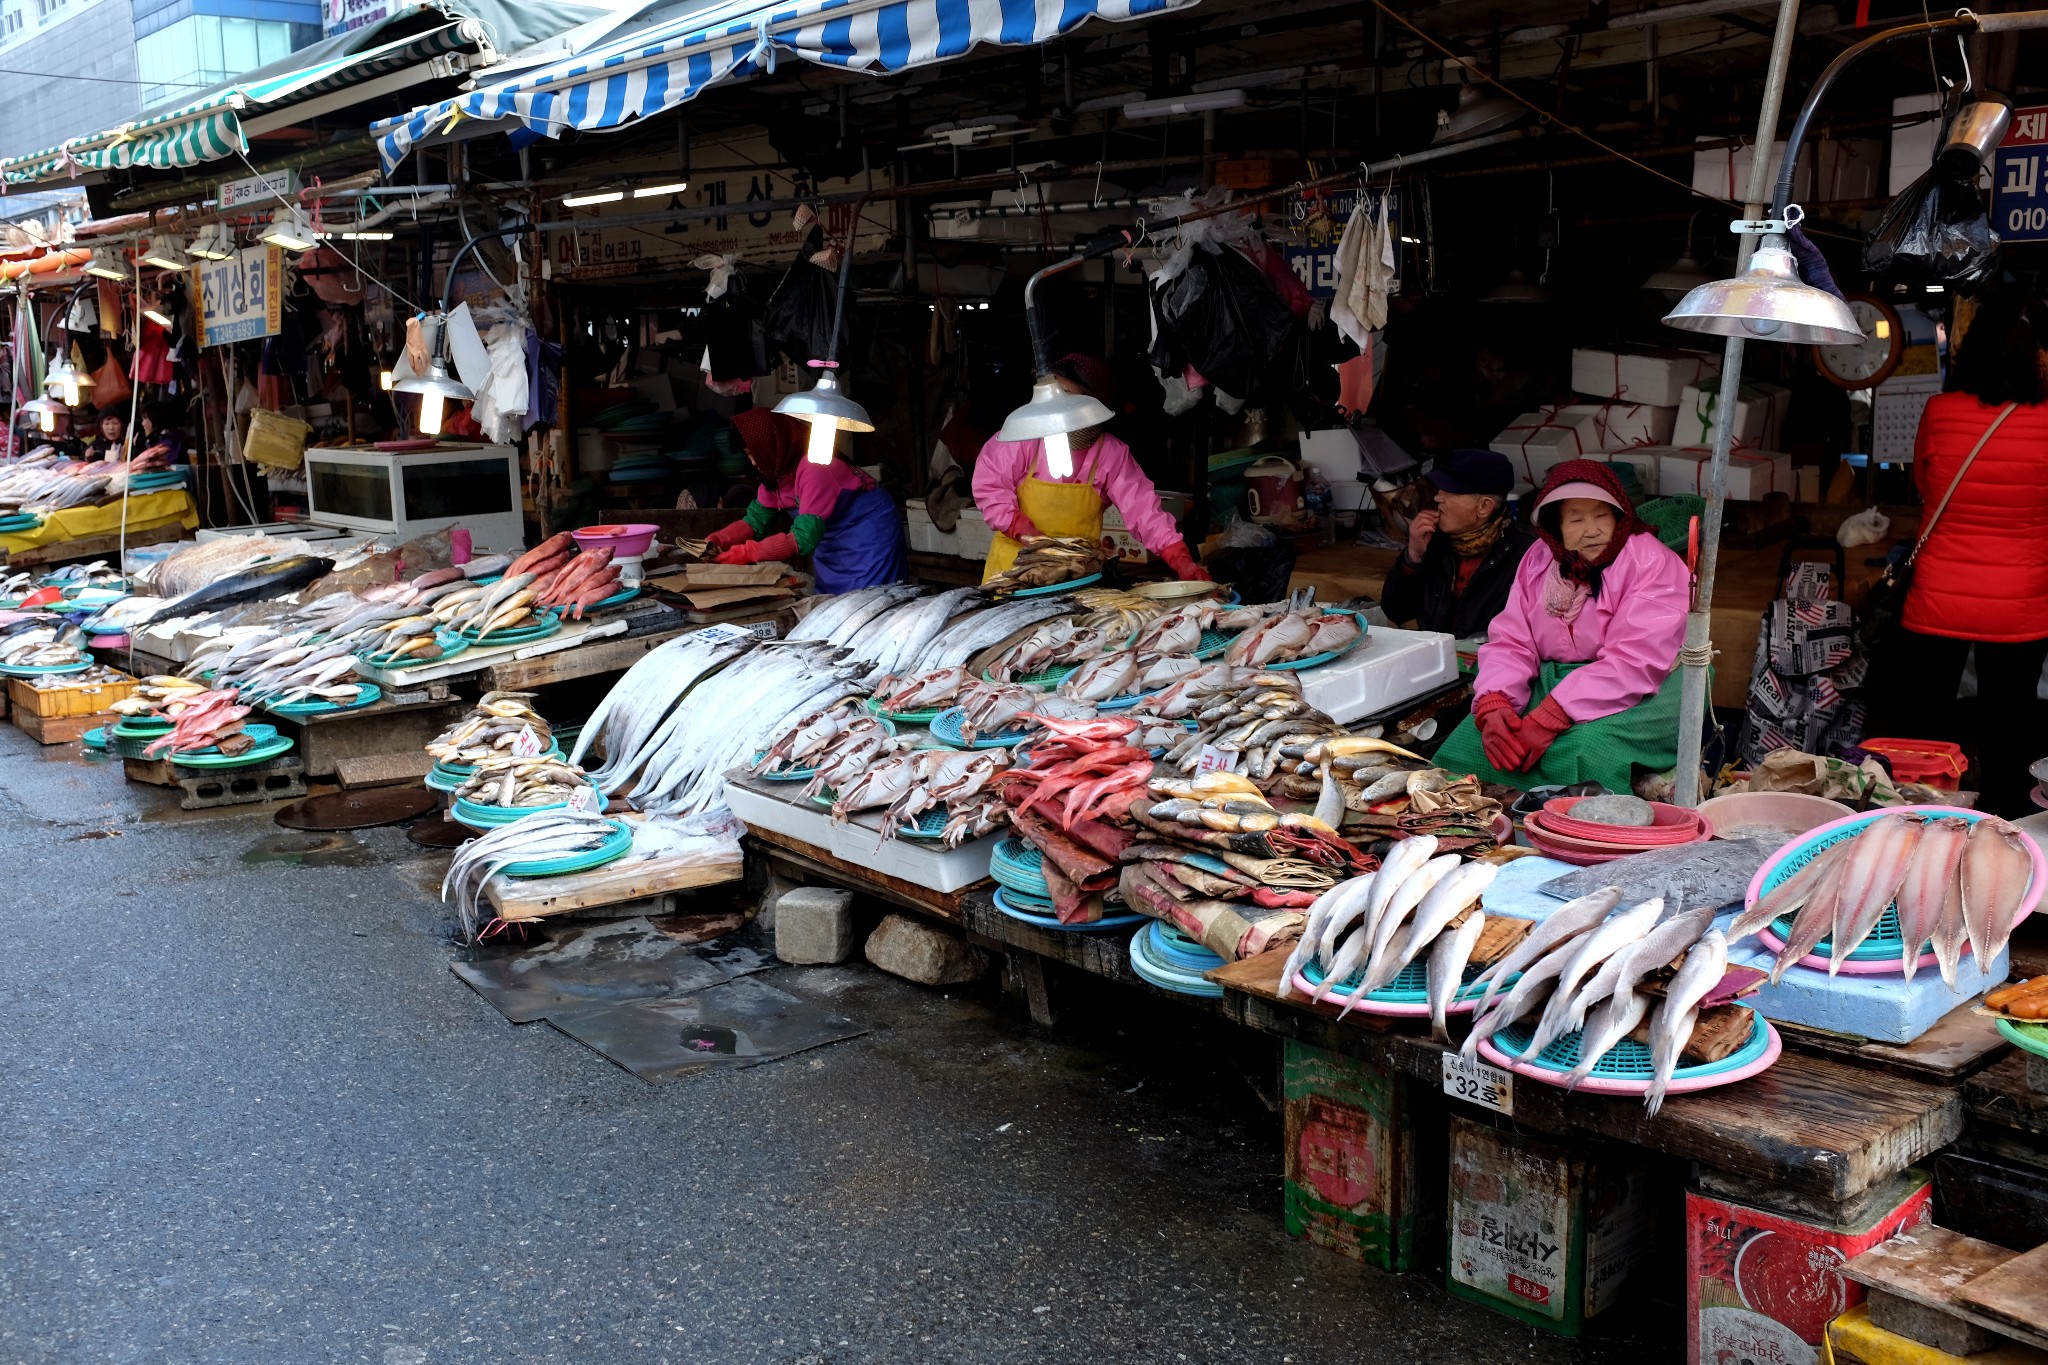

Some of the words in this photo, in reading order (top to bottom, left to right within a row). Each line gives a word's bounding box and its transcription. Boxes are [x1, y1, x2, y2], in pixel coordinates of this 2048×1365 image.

[2001, 155, 2048, 198] 괴
[2008, 207, 2048, 232] 010
[201, 258, 265, 320] 조개상회
[269, 247, 279, 329] 택배전문
[1759, 674, 1783, 704] Real
[519, 731, 537, 757] 국산
[1456, 1075, 1501, 1107] 32호
[1480, 1215, 1560, 1264] 사계절
